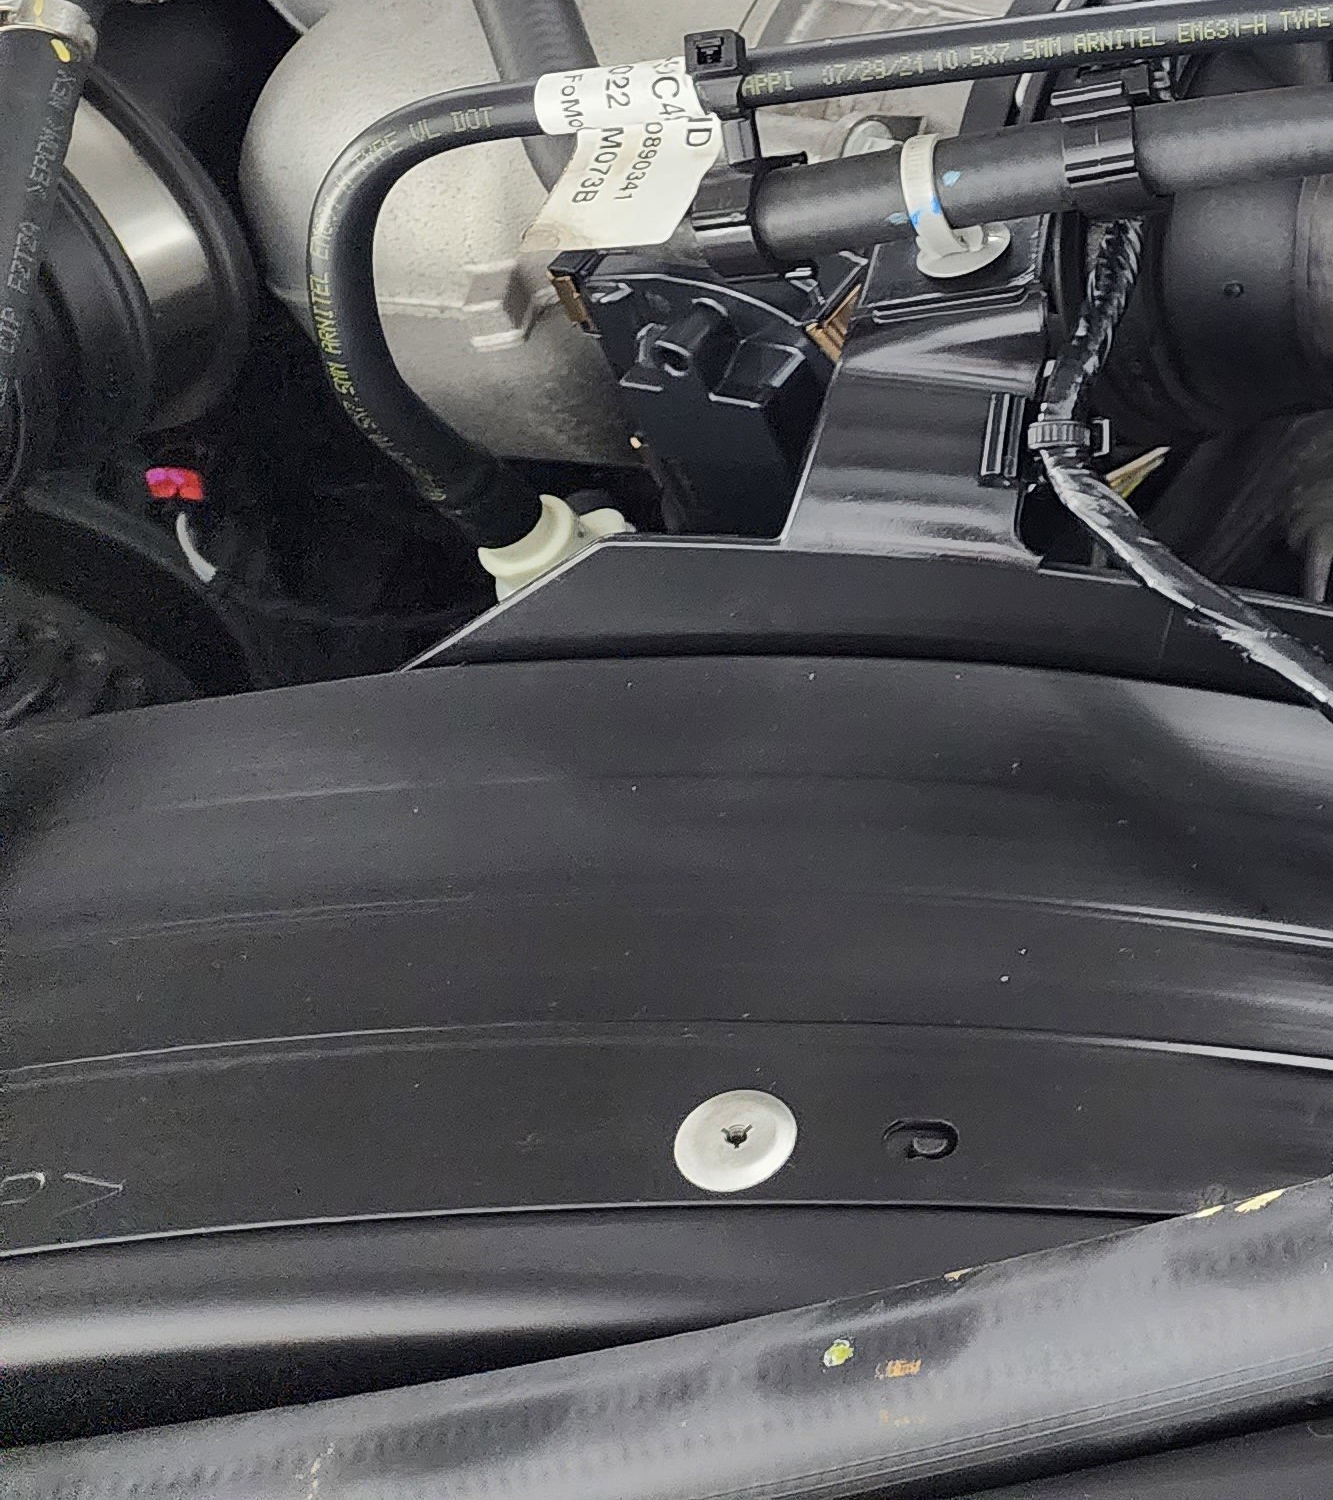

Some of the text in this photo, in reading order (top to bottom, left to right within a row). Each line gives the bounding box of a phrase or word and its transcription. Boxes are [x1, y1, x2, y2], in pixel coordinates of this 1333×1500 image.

[741, 70, 794, 97] APPI
[822, 54, 924, 86] 07/29/21
[1074, 26, 1167, 55] ARNITEL
[1176, 13, 1268, 44] EM631-H
[1279, 6, 1332, 33] TYPE
[572, 127, 625, 203] M073B
[614, 121, 664, 200] 0890341
[310, 272, 342, 356] ARNITEL
[451, 106, 494, 133] DOT
